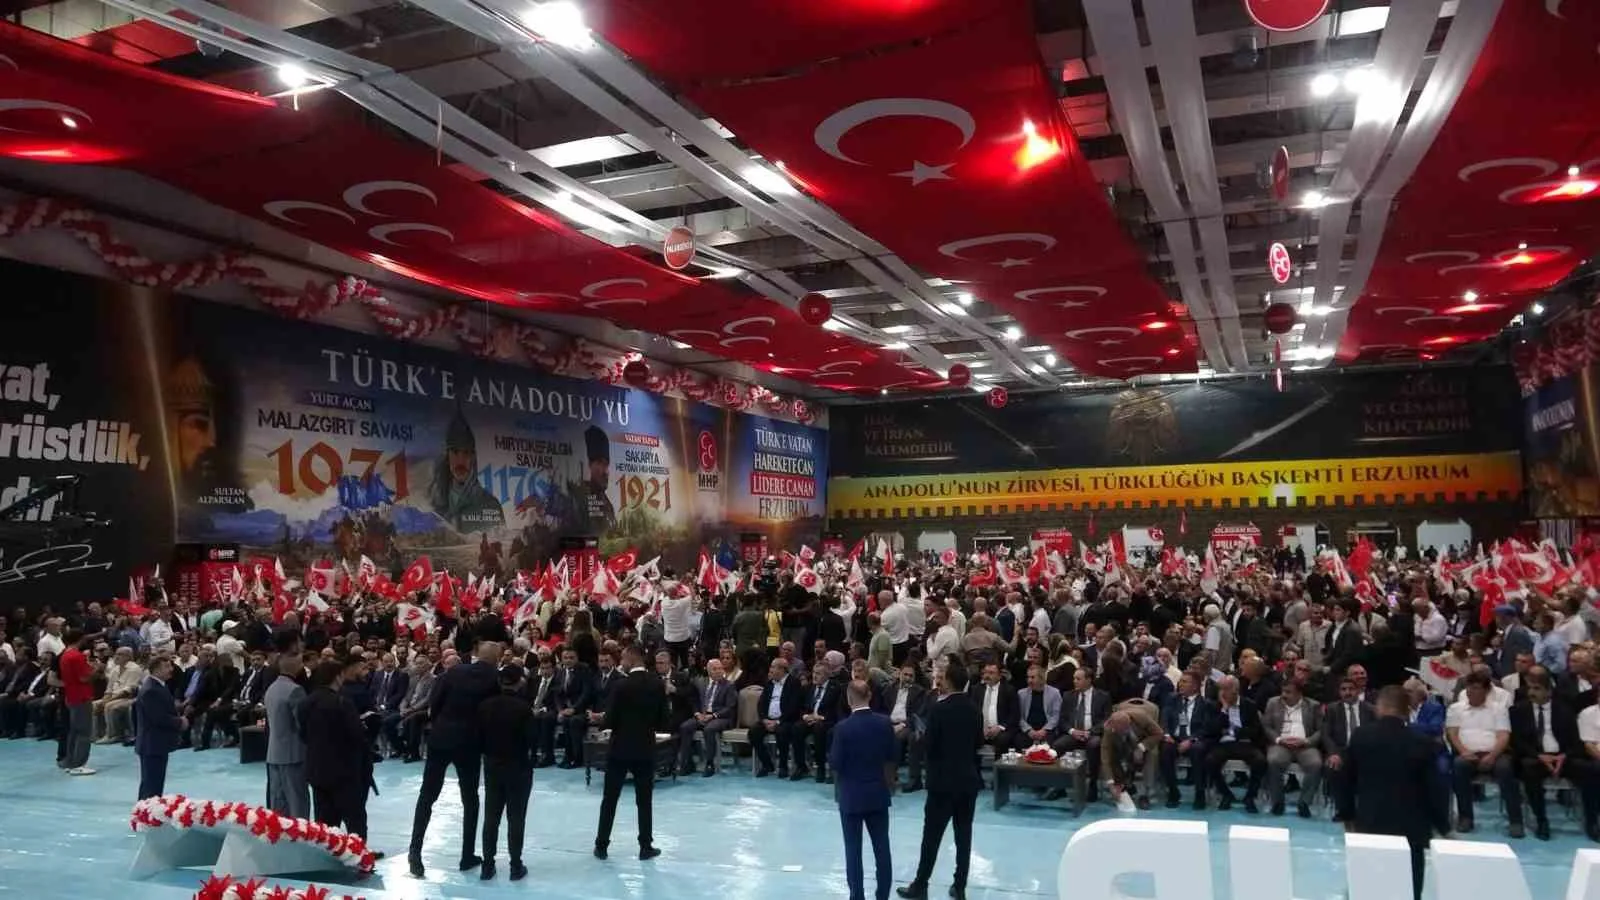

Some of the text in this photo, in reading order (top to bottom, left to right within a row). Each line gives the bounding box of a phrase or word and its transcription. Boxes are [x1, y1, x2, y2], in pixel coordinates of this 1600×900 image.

[0, 361, 62, 412] at,
[321, 348, 456, 400] TÜRK'E
[266, 438, 410, 503] 1071
[698, 473, 719, 489] MHP
[863, 464, 1471, 498] ANADOLU'NUN ZİRVESİ, TÜRKLÜĞÜN BAŞKENTİ ERZURUM
[616, 474, 672, 512] 1921
